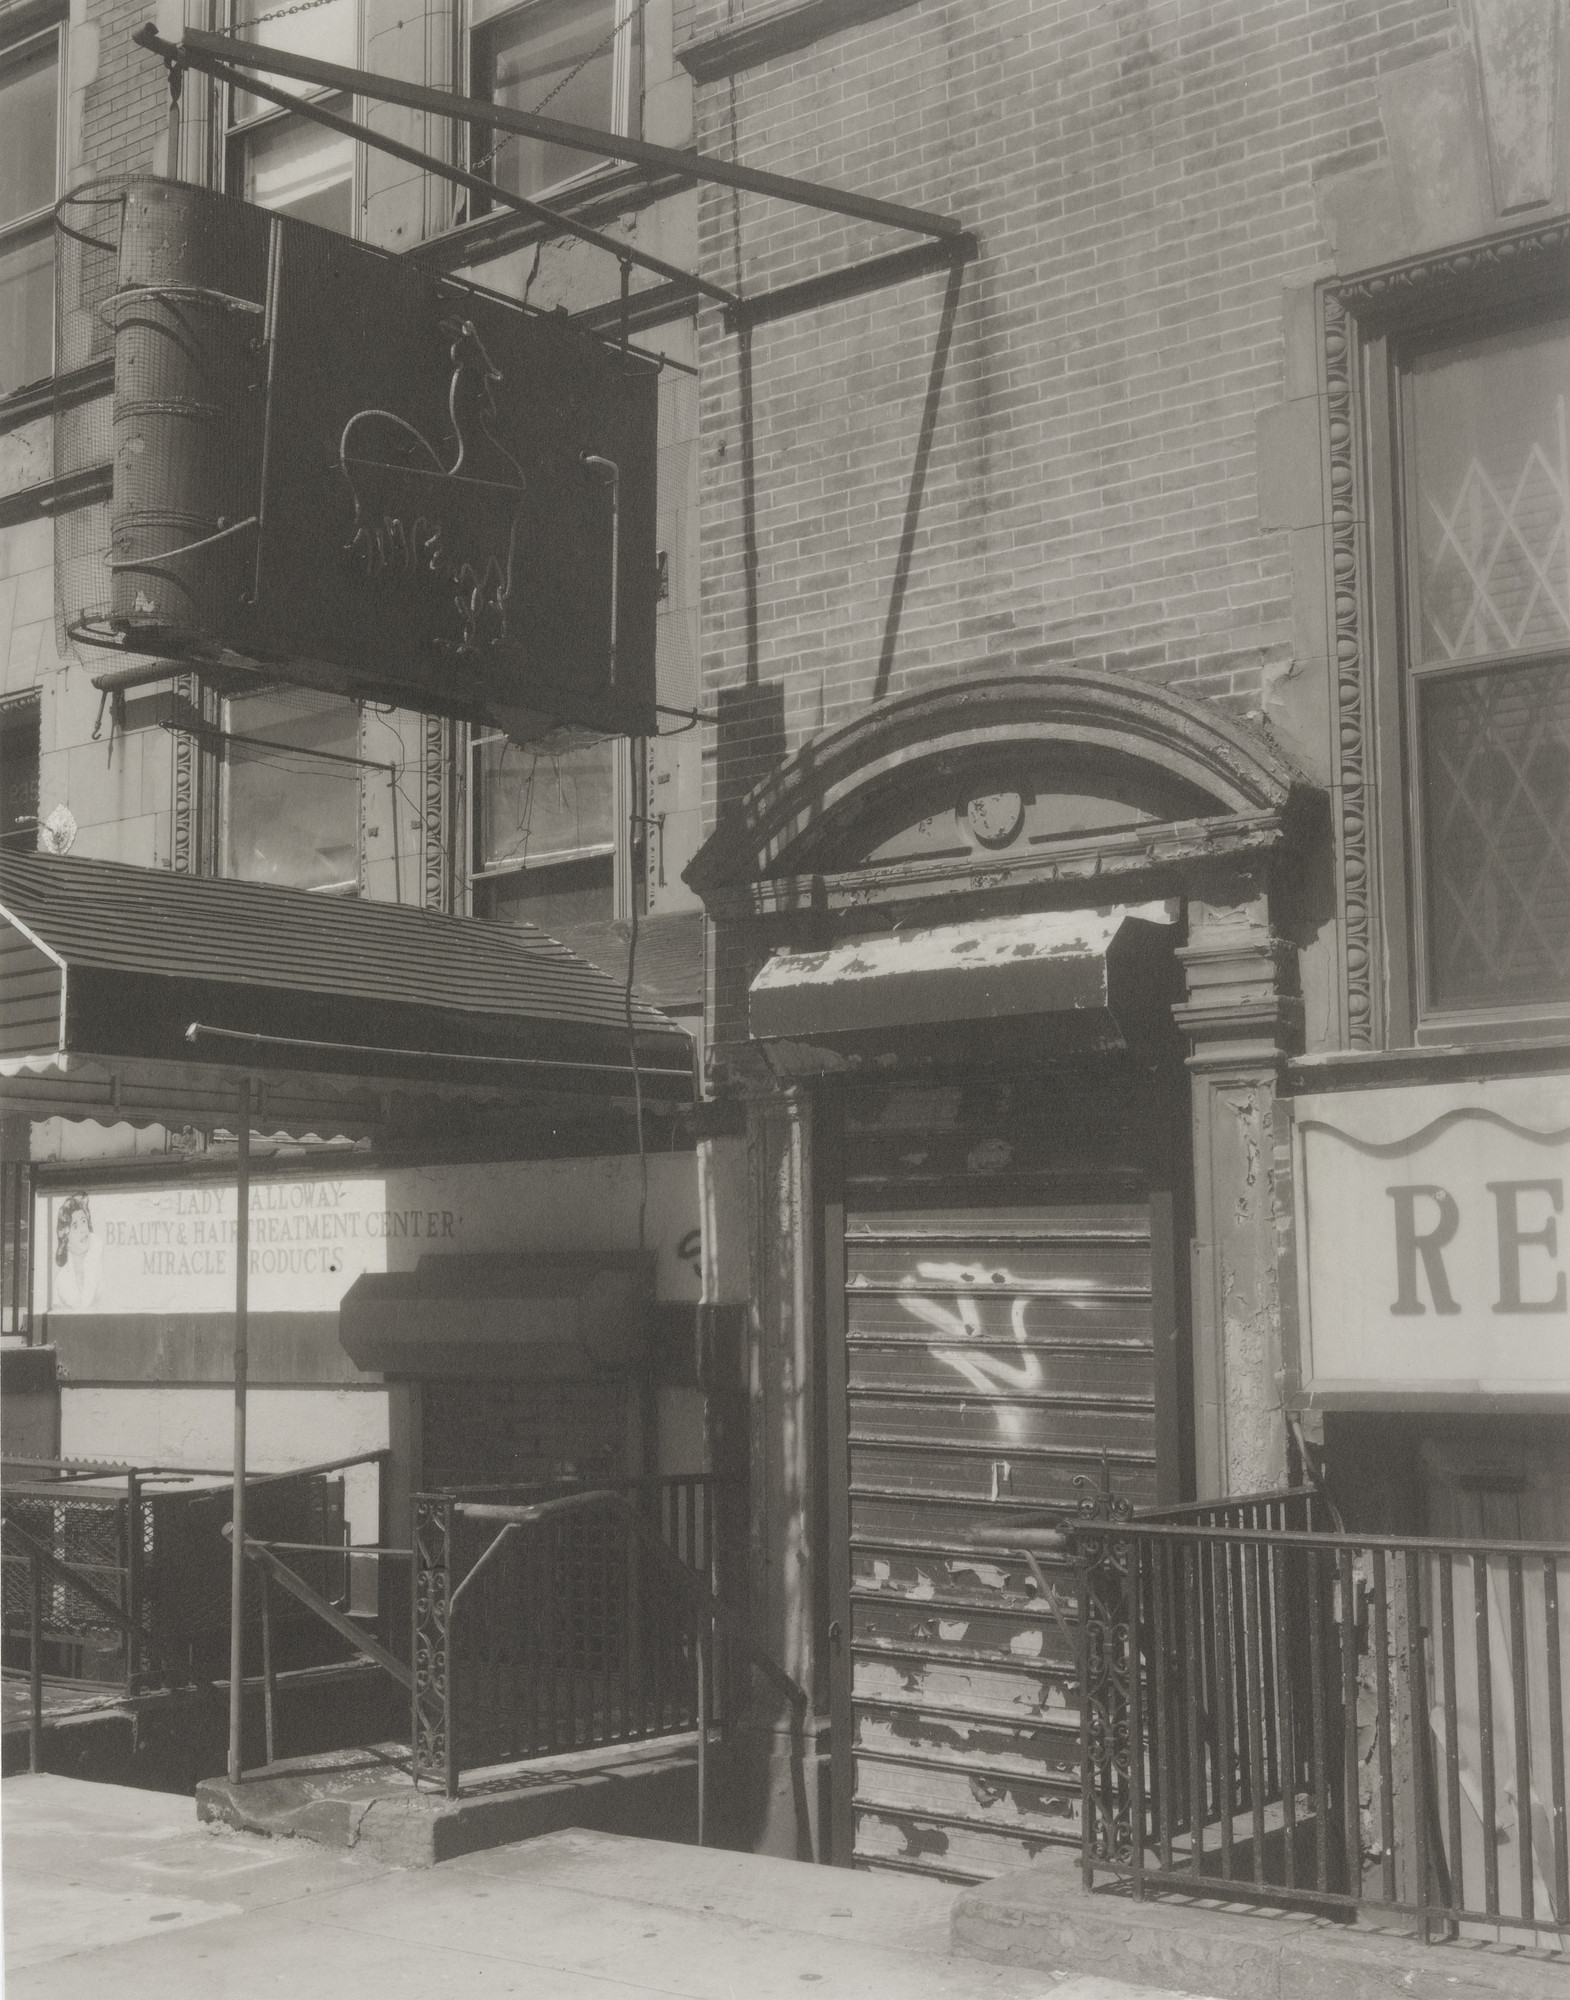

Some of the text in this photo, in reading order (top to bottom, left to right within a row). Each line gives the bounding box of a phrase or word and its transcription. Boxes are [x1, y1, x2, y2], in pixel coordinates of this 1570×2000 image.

[176, 1181, 343, 1216] LADY ALLOWAY
[143, 1246, 344, 1276] MIRACLE RODUCTS
[1384, 1178, 1568, 1316] RE
